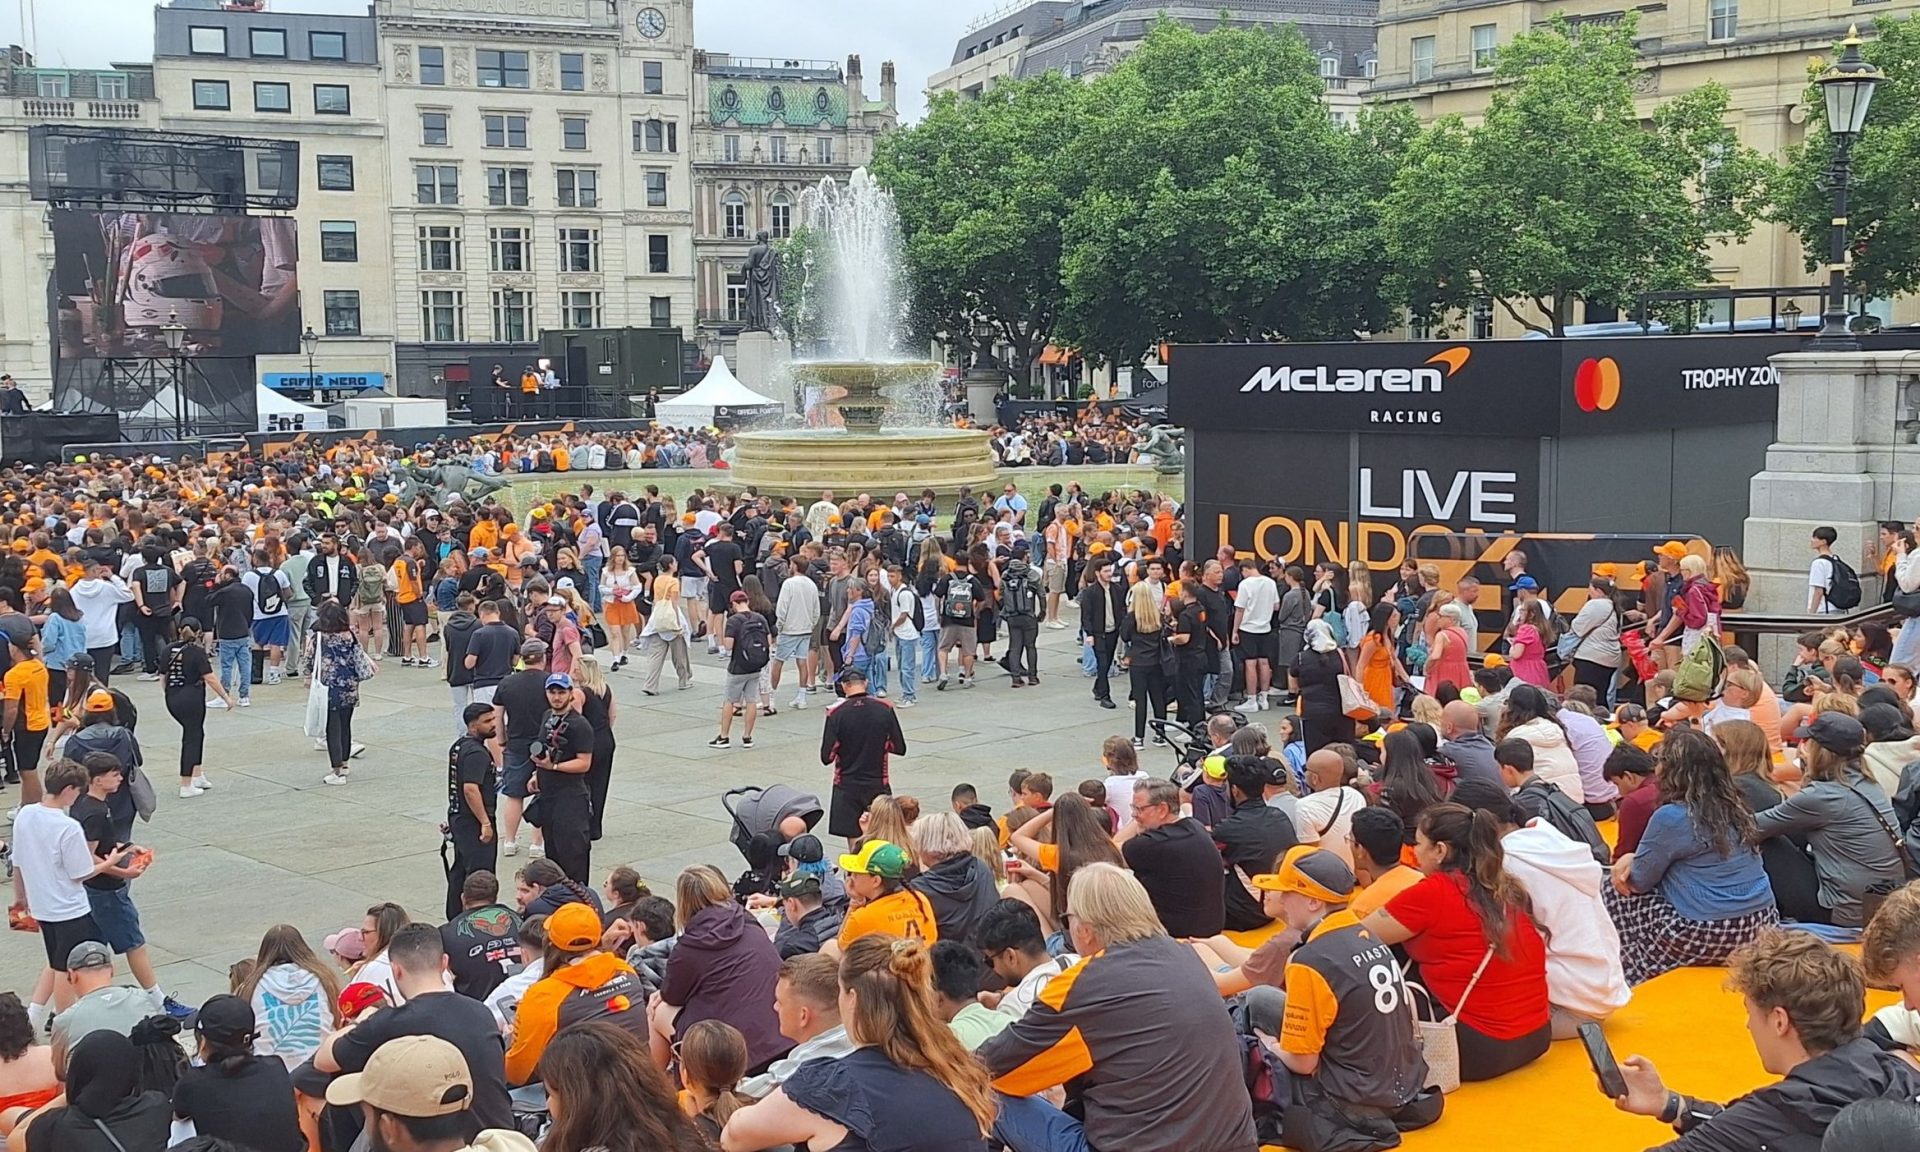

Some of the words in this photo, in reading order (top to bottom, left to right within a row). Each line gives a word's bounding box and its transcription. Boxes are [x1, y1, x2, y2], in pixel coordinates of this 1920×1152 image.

[515, 0, 585, 18] PACIFIC
[329, 376, 367, 386] NERO
[1240, 366, 1442, 393] McLaren
[1681, 367, 1748, 389] TROPHY
[1749, 366, 1780, 386] ZON
[1370, 410, 1442, 423] RACING
[1359, 467, 1517, 523] LIVE
[1352, 944, 1391, 967] PIAST
